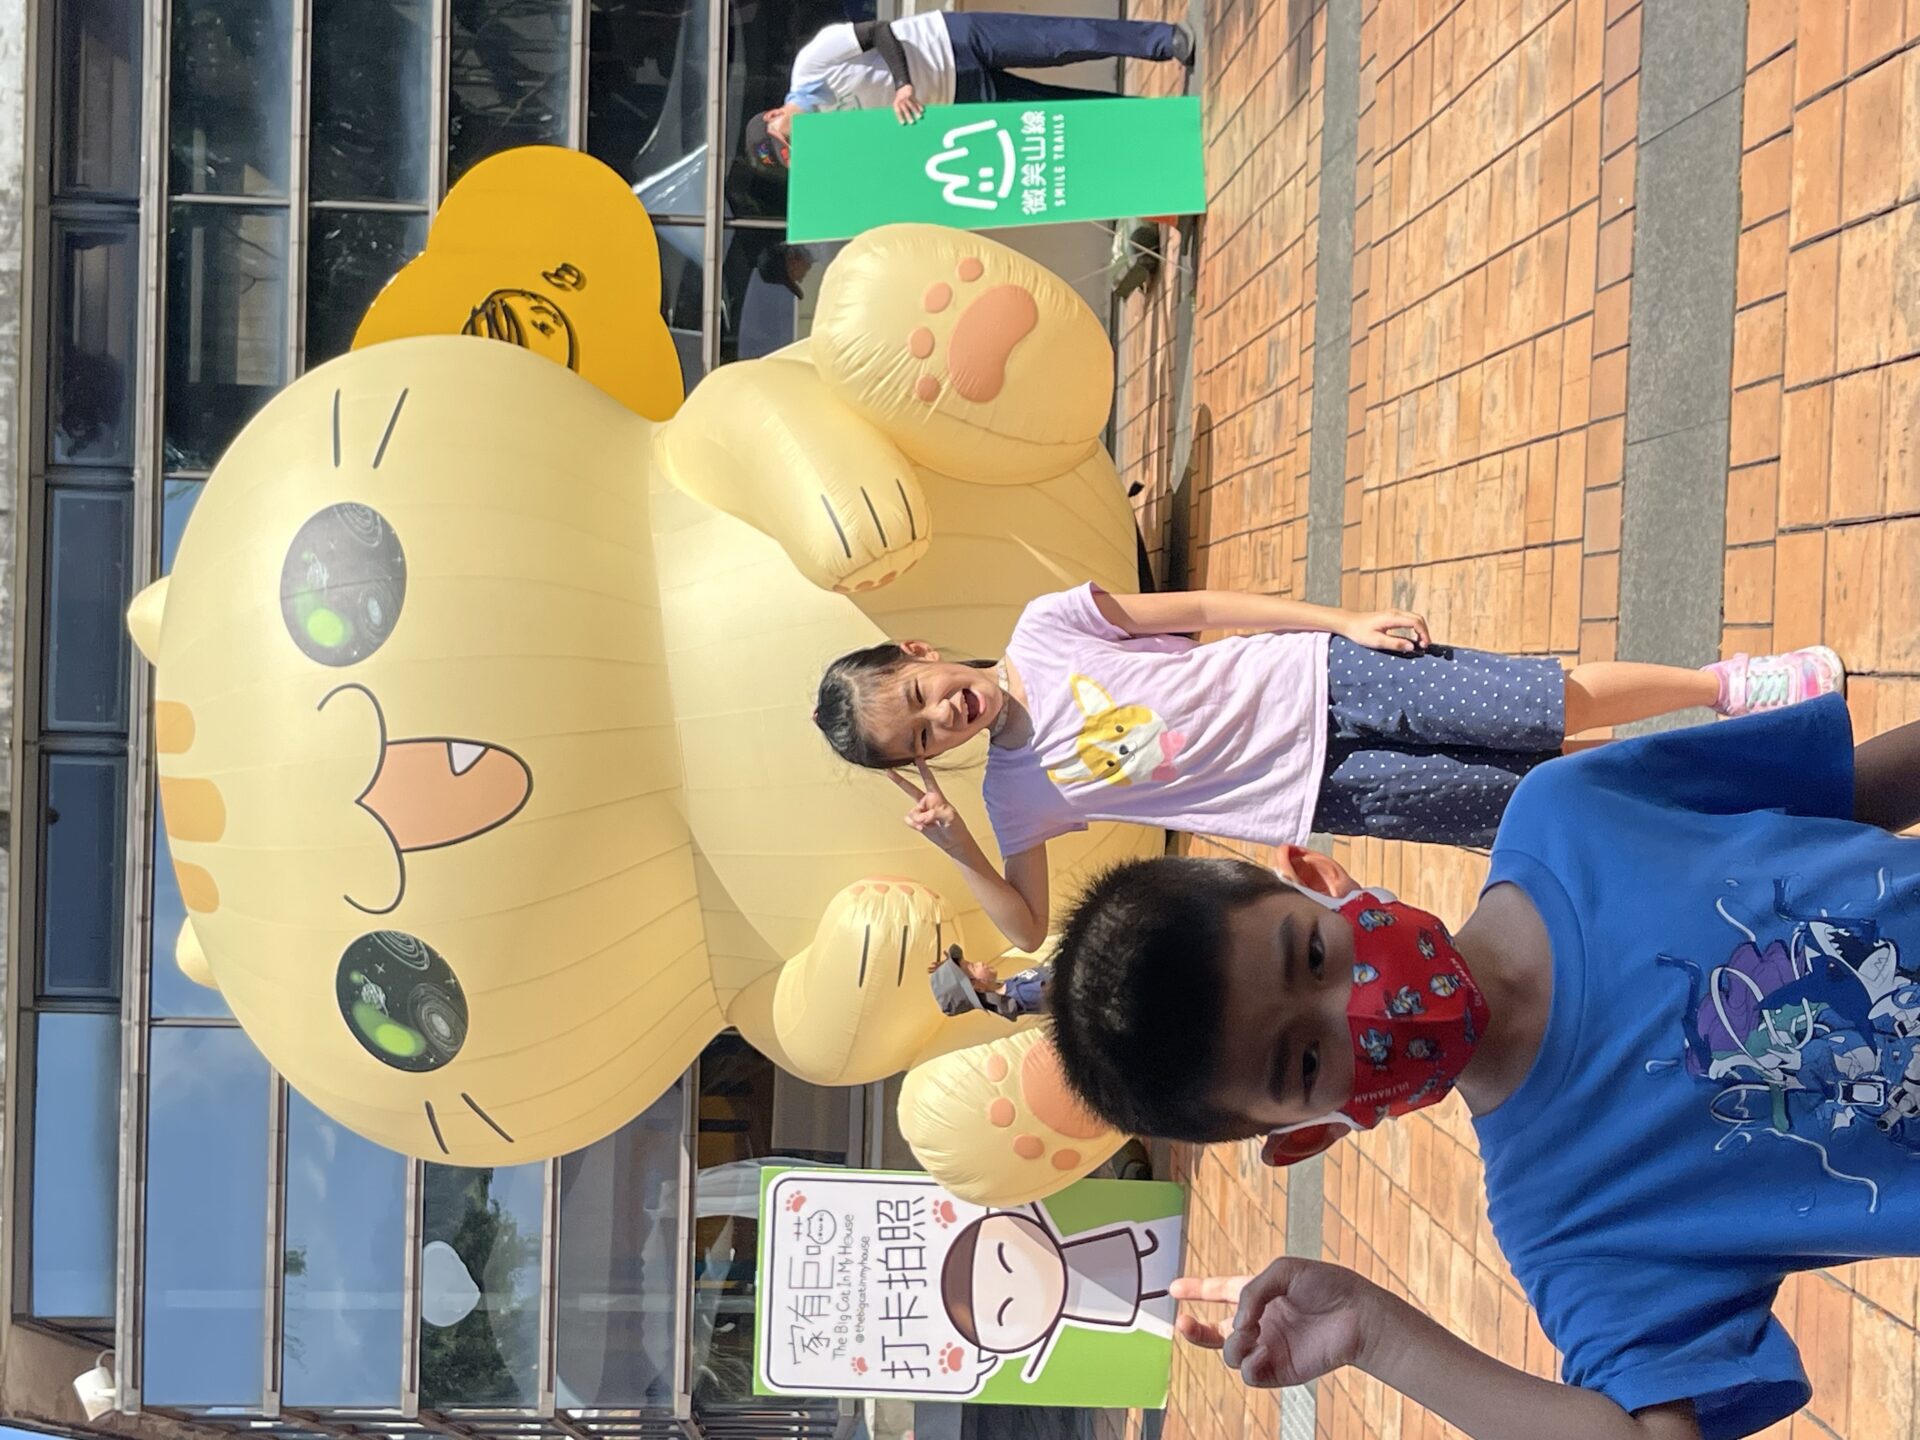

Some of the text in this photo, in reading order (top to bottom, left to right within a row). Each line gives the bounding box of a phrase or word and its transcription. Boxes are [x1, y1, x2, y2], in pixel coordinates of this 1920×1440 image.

[1020, 111, 1047, 215] 微笑山線
[1052, 114, 1066, 207] SMILE TRAILS
[833, 1215, 854, 1359] The Big Cat In My House
[856, 1236, 871, 1343] @thebigcatinmyhouse
[876, 1197, 930, 1379] 打卡拍照
